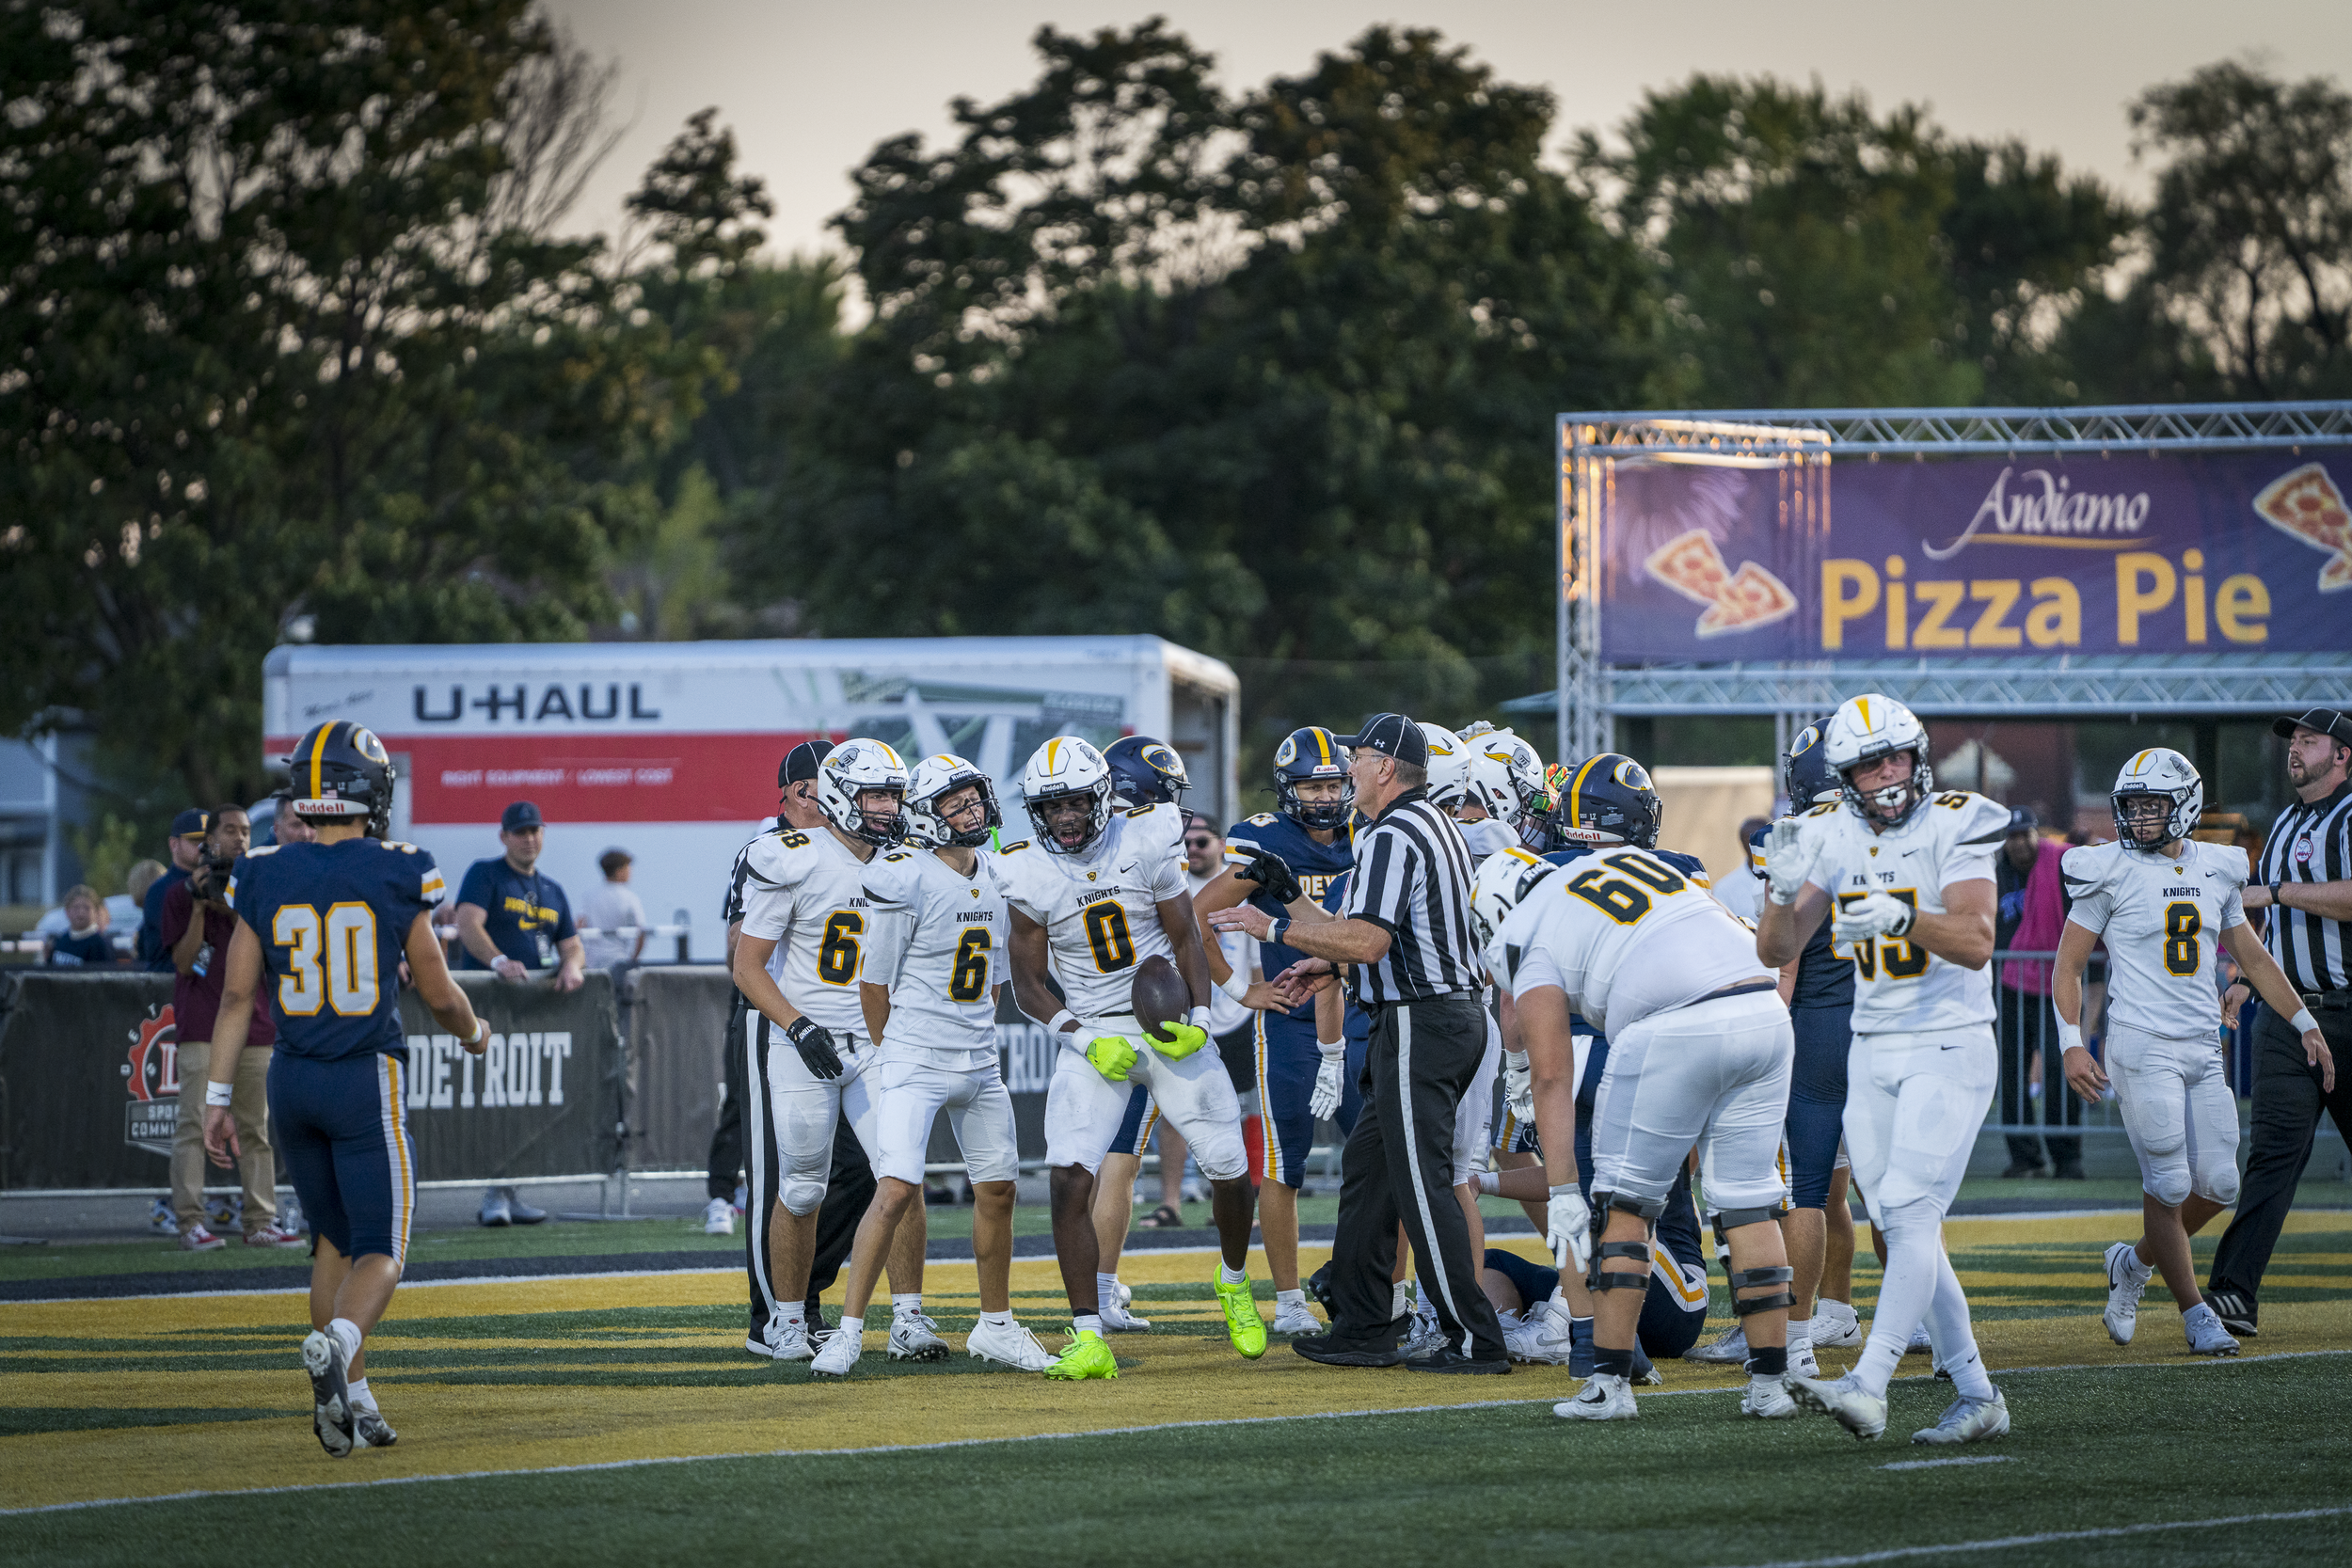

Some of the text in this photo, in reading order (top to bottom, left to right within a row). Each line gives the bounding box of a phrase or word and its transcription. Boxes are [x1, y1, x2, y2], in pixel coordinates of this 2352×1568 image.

[1922, 466, 2150, 561] Andiamo
[1821, 548, 2273, 651] Pizza Pie
[412, 683, 660, 722] U-HAUL
[951, 770, 973, 781] Riddell
[1041, 783, 1065, 792] Riddell
[298, 802, 345, 814] Riddell
[1565, 829, 1601, 841] Riddell
[1075, 885, 1120, 908] KNIGHTS
[1565, 852, 1688, 927] 60
[2162, 887, 2201, 897] KNIGHTS
[956, 911, 993, 923] KNIGHTS
[1083, 898, 1136, 974] 0
[816, 910, 869, 987] 6
[2164, 901, 2202, 976] 8
[272, 900, 380, 1017] 30
[947, 926, 993, 1003] 6
[407, 1032, 572, 1109] DETROIT
[898, 1329, 912, 1341] N
[1801, 1355, 1816, 1367] NIKE
